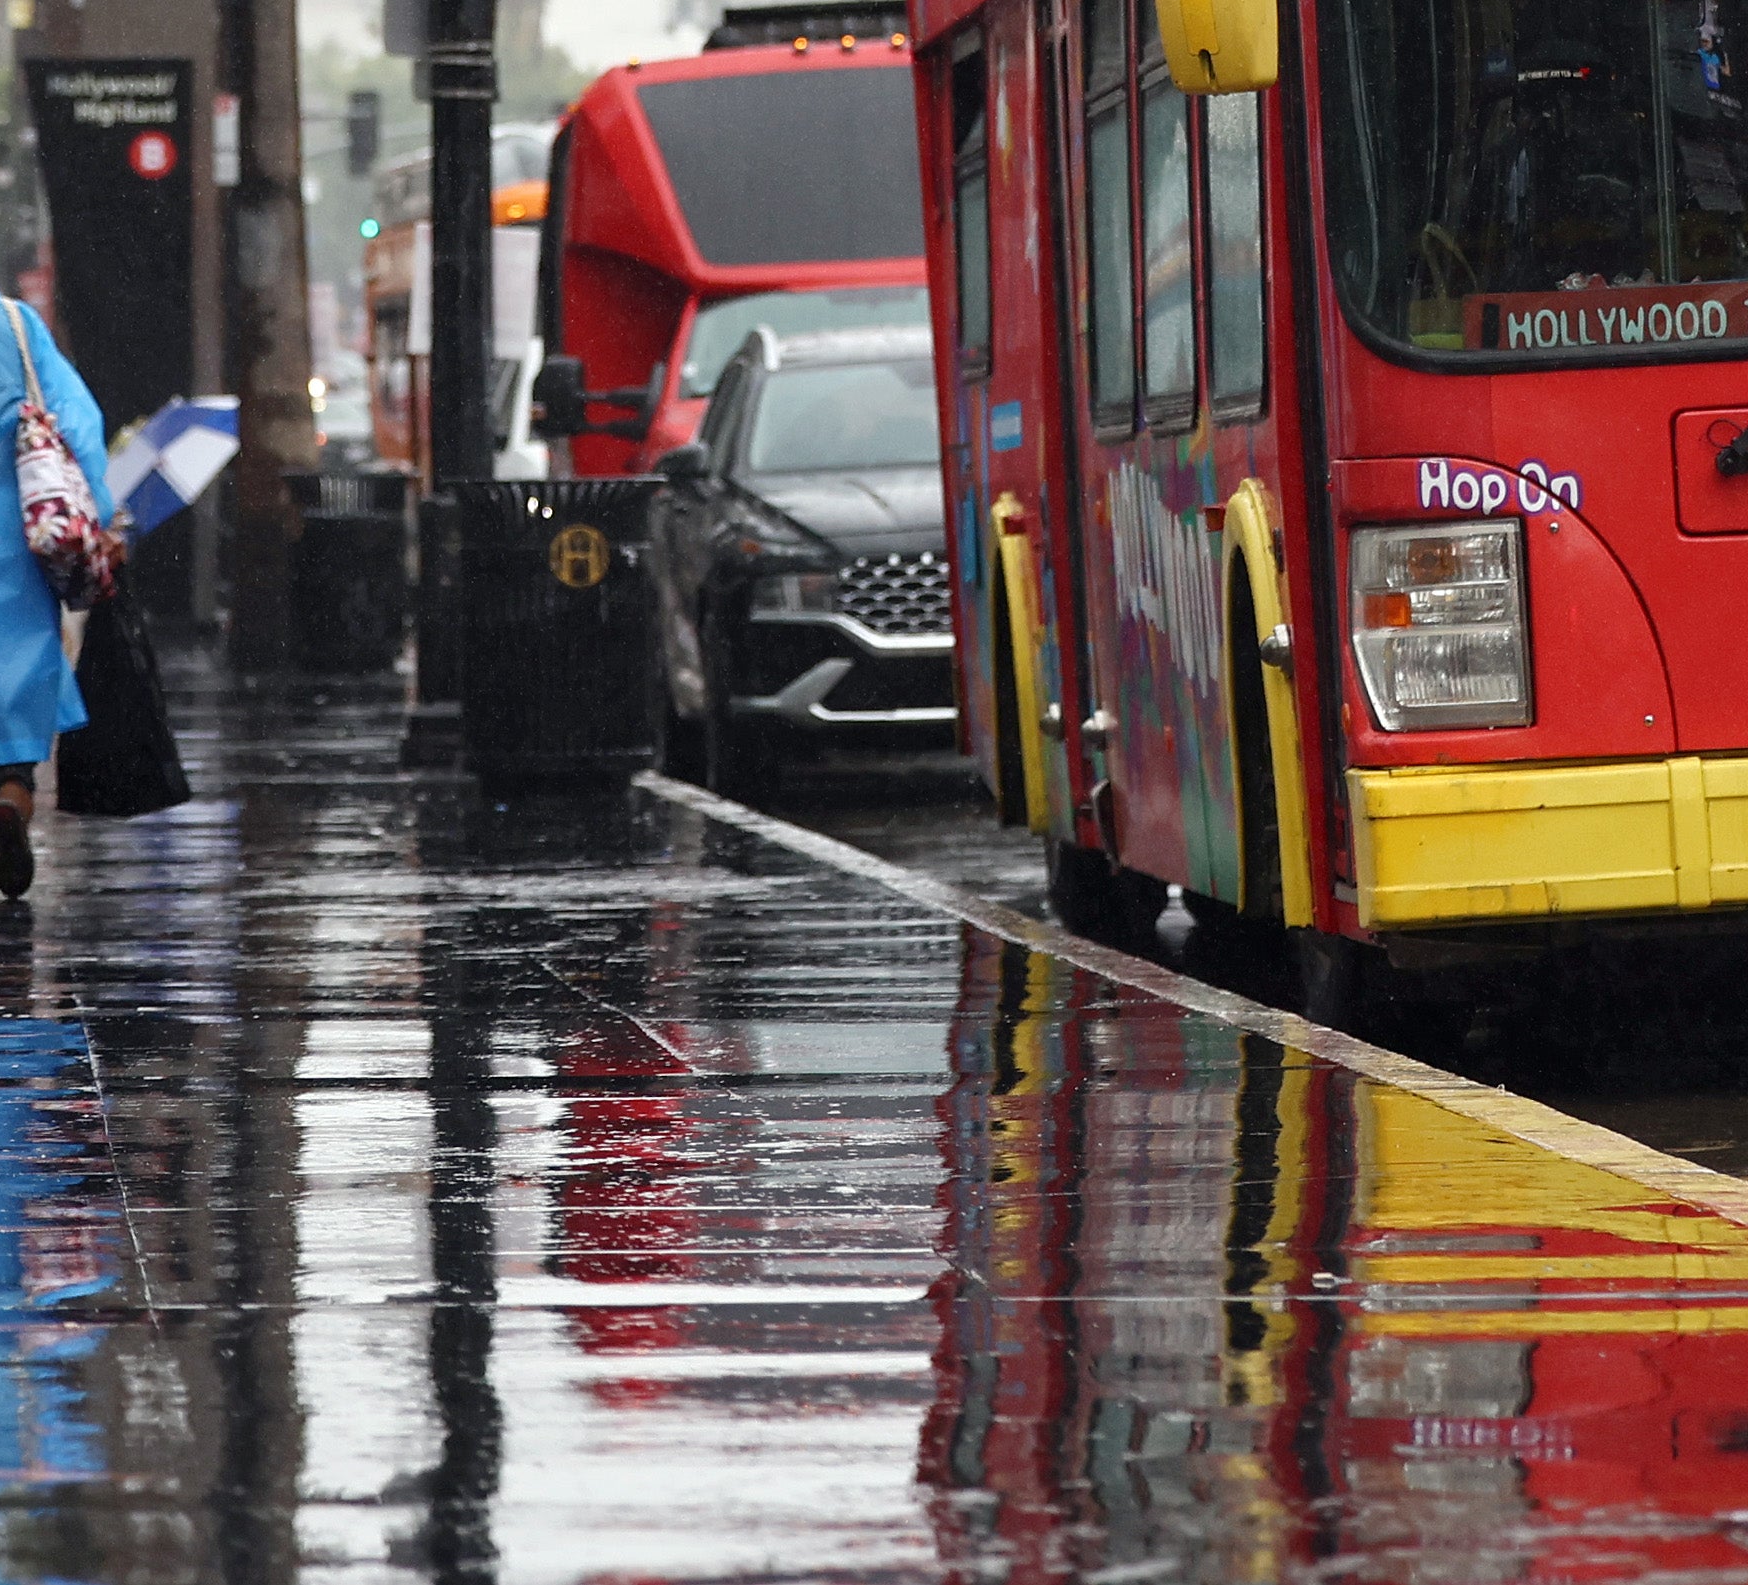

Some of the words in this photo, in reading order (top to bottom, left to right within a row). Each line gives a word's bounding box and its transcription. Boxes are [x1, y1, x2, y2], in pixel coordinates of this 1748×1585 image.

[1506, 298, 1729, 351] HOLLYWOOD
[1418, 459, 1509, 517] Hop
[1518, 461, 1581, 514] On
